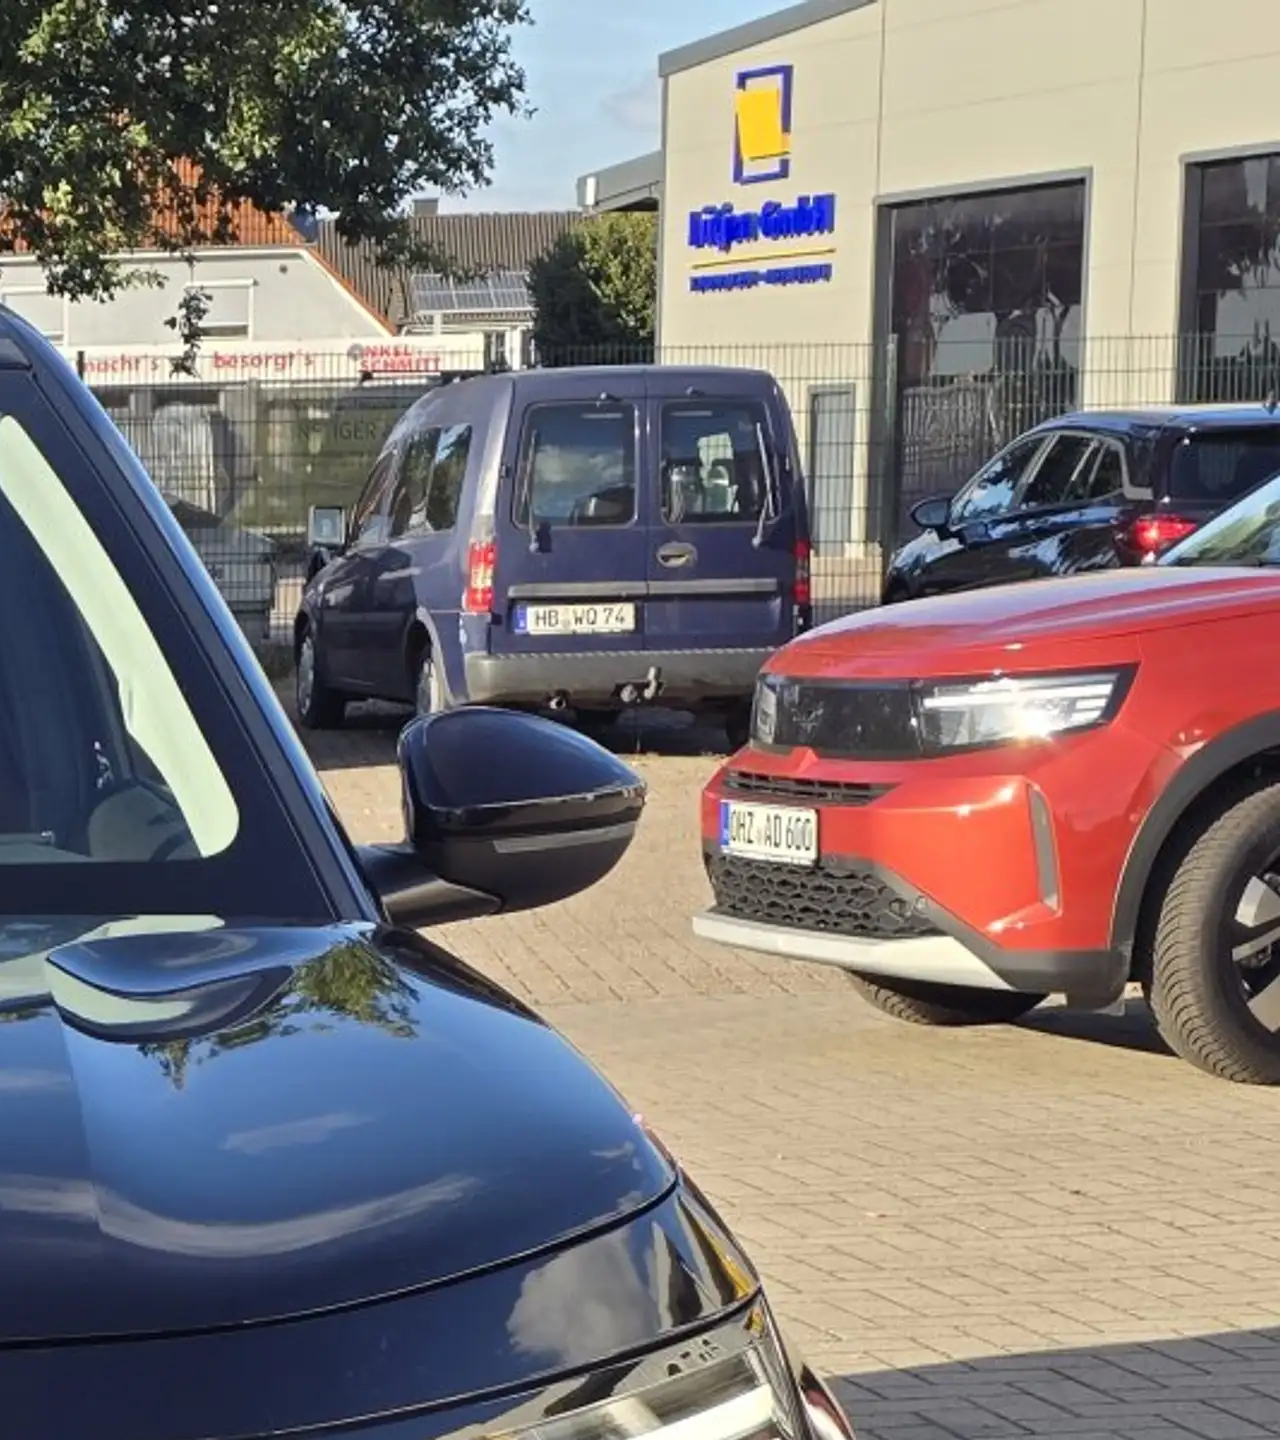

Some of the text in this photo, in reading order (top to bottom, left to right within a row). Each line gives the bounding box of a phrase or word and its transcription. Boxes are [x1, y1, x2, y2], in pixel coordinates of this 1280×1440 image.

[534, 608, 559, 628] HB
[602, 605, 626, 625] 74
[731, 809, 755, 844] OHZ
